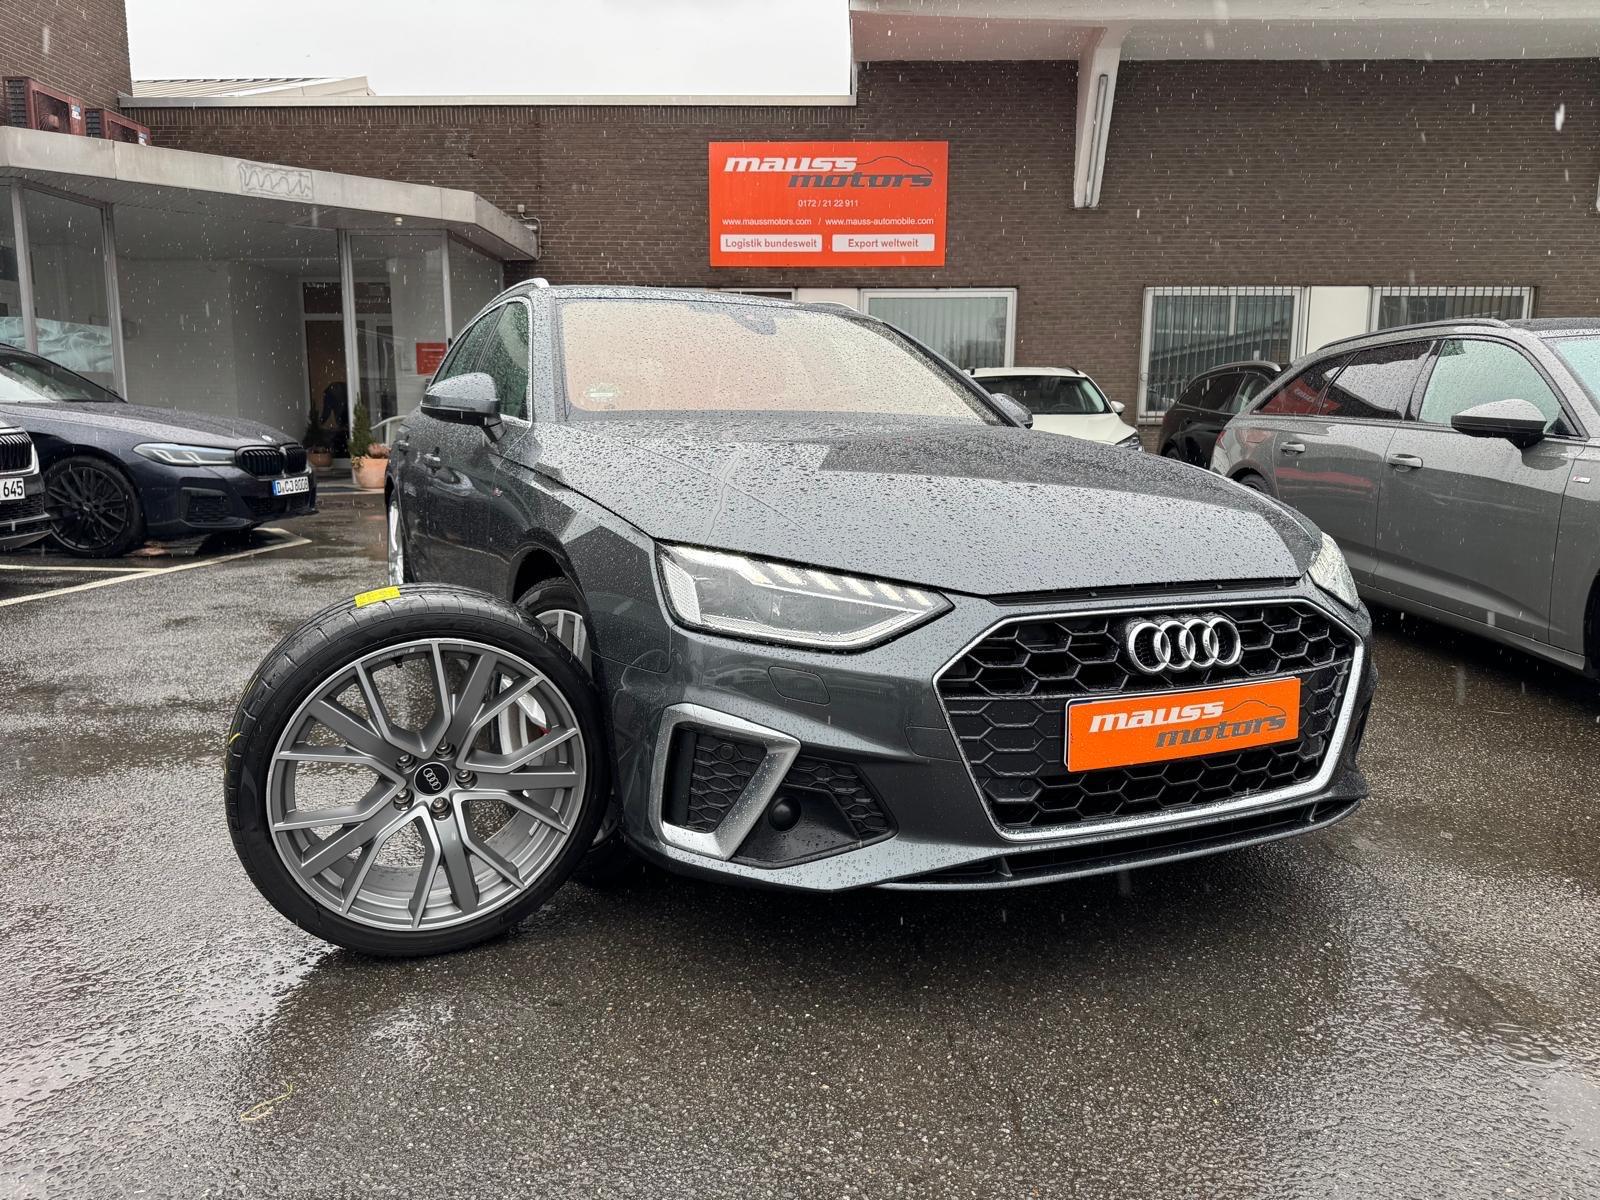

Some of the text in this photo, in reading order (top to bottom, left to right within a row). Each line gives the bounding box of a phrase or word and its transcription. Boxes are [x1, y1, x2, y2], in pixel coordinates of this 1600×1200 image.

[723, 156, 858, 173] mauss
[788, 172, 934, 188] motors
[797, 199, 817, 208] 0172
[822, 199, 832, 208] 21
[833, 199, 844, 208] 22
[845, 199, 858, 208] 911
[721, 217, 812, 226] www.maussmotors.com
[824, 216, 934, 226] www.mauss-automobile.com
[725, 238, 818, 250] Logistik bundesweit
[848, 238, 919, 250] Export weltweit
[3, 480, 24, 498] 645
[1088, 701, 1225, 733] mauss
[1154, 712, 1288, 749] motors
